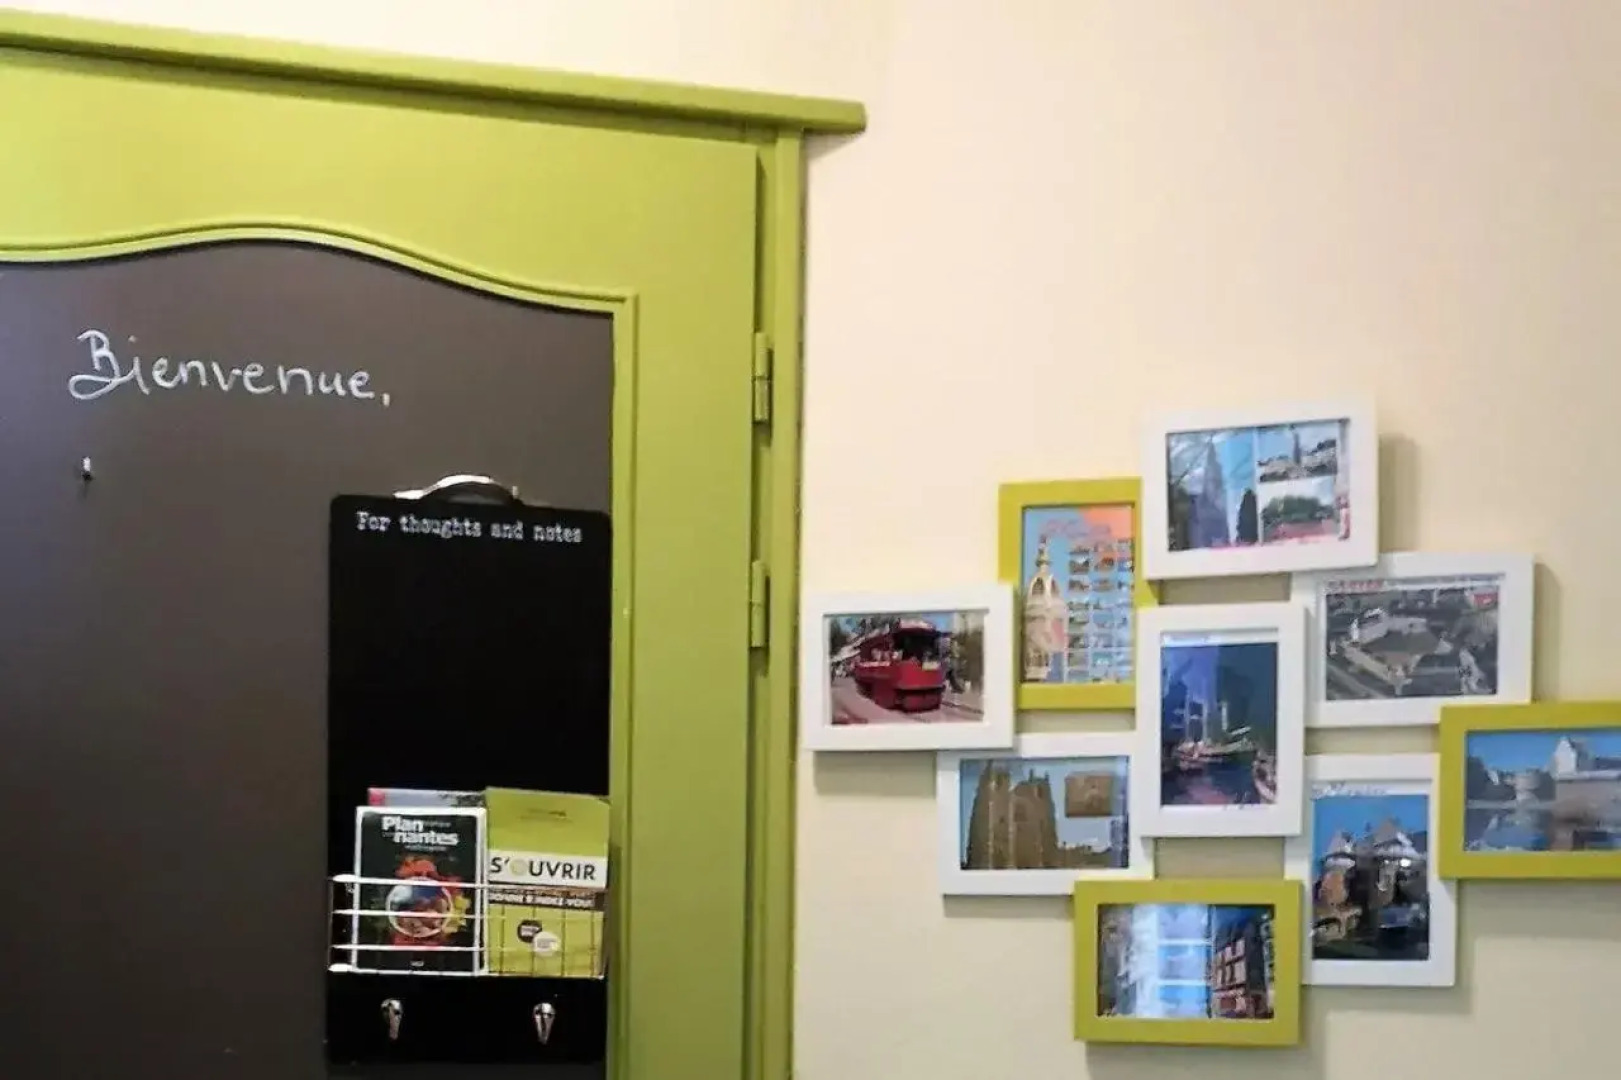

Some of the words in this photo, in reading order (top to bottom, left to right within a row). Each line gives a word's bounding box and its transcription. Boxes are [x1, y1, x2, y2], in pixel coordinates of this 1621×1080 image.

[356, 510, 391, 532] For
[399, 516, 482, 539] thoughts
[490, 520, 525, 540] and
[533, 524, 583, 543] notes
[382, 816, 424, 832] Plan
[393, 831, 459, 846] nantes
